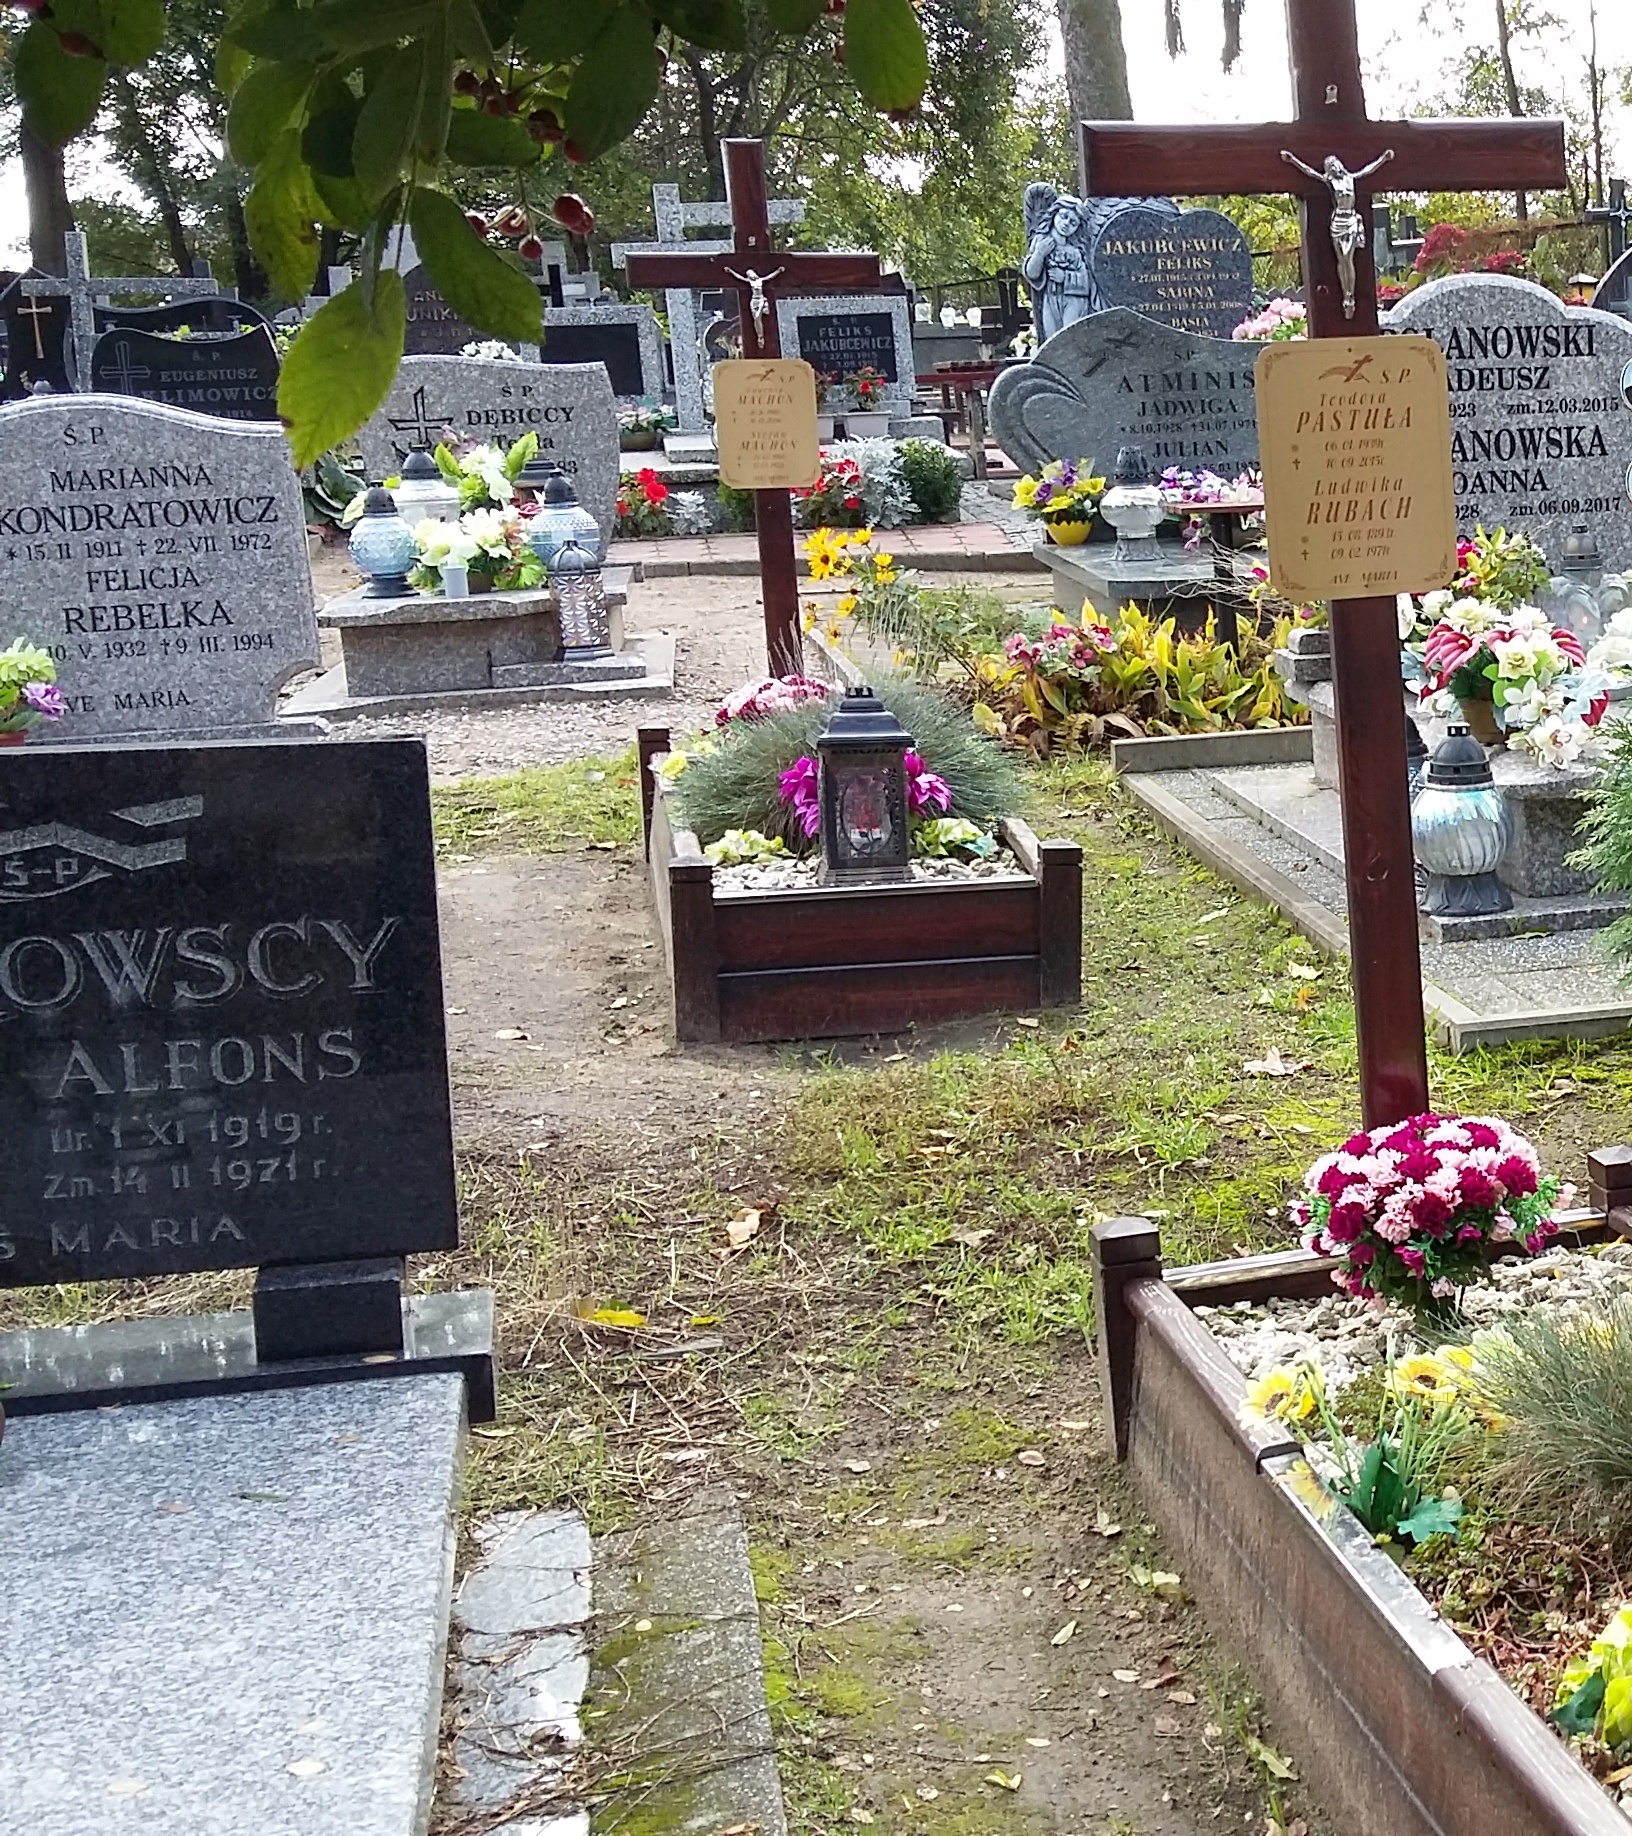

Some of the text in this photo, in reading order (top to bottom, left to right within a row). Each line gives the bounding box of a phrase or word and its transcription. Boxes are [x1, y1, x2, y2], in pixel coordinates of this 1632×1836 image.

[1103, 238, 1242, 255] JAKUBCEWICZ
[1157, 257, 1212, 270] FELIKS
[1157, 286, 1214, 299] SABINA
[803, 336, 892, 352] JAKUBCEWICZ
[819, 326, 872, 337] FELIKS
[160, 368, 258, 382] EUGENIUSZ
[1117, 371, 1255, 393] ATMINIS
[1138, 398, 1239, 417] JADWIGA
[1320, 391, 1387, 407] Teodora
[466, 406, 575, 430] DĘBICCY
[1296, 406, 1412, 434] PASTUŁA
[1153, 440, 1229, 458] JULIAN
[49, 464, 214, 493] MARIANNA
[1315, 475, 1403, 496] Ludwika
[0, 496, 279, 536] KONDRATOWICZ
[1307, 496, 1412, 525] RUBACH
[85, 541, 124, 559] 1911
[231, 533, 272, 552] 1972
[86, 566, 201, 594] FELICJA
[62, 599, 235, 635] REBELKA
[104, 640, 147, 659] 1932
[232, 633, 275, 652] 1994
[62, 689, 191, 716] VE MARIA
[50, 1029, 363, 1099] ALFONS
[149, 1119, 187, 1146] XI
[204, 1106, 301, 1149] 1919
[110, 1164, 148, 1195] 14
[207, 1149, 298, 1191] 1971
[50, 1213, 247, 1257] MARIA
